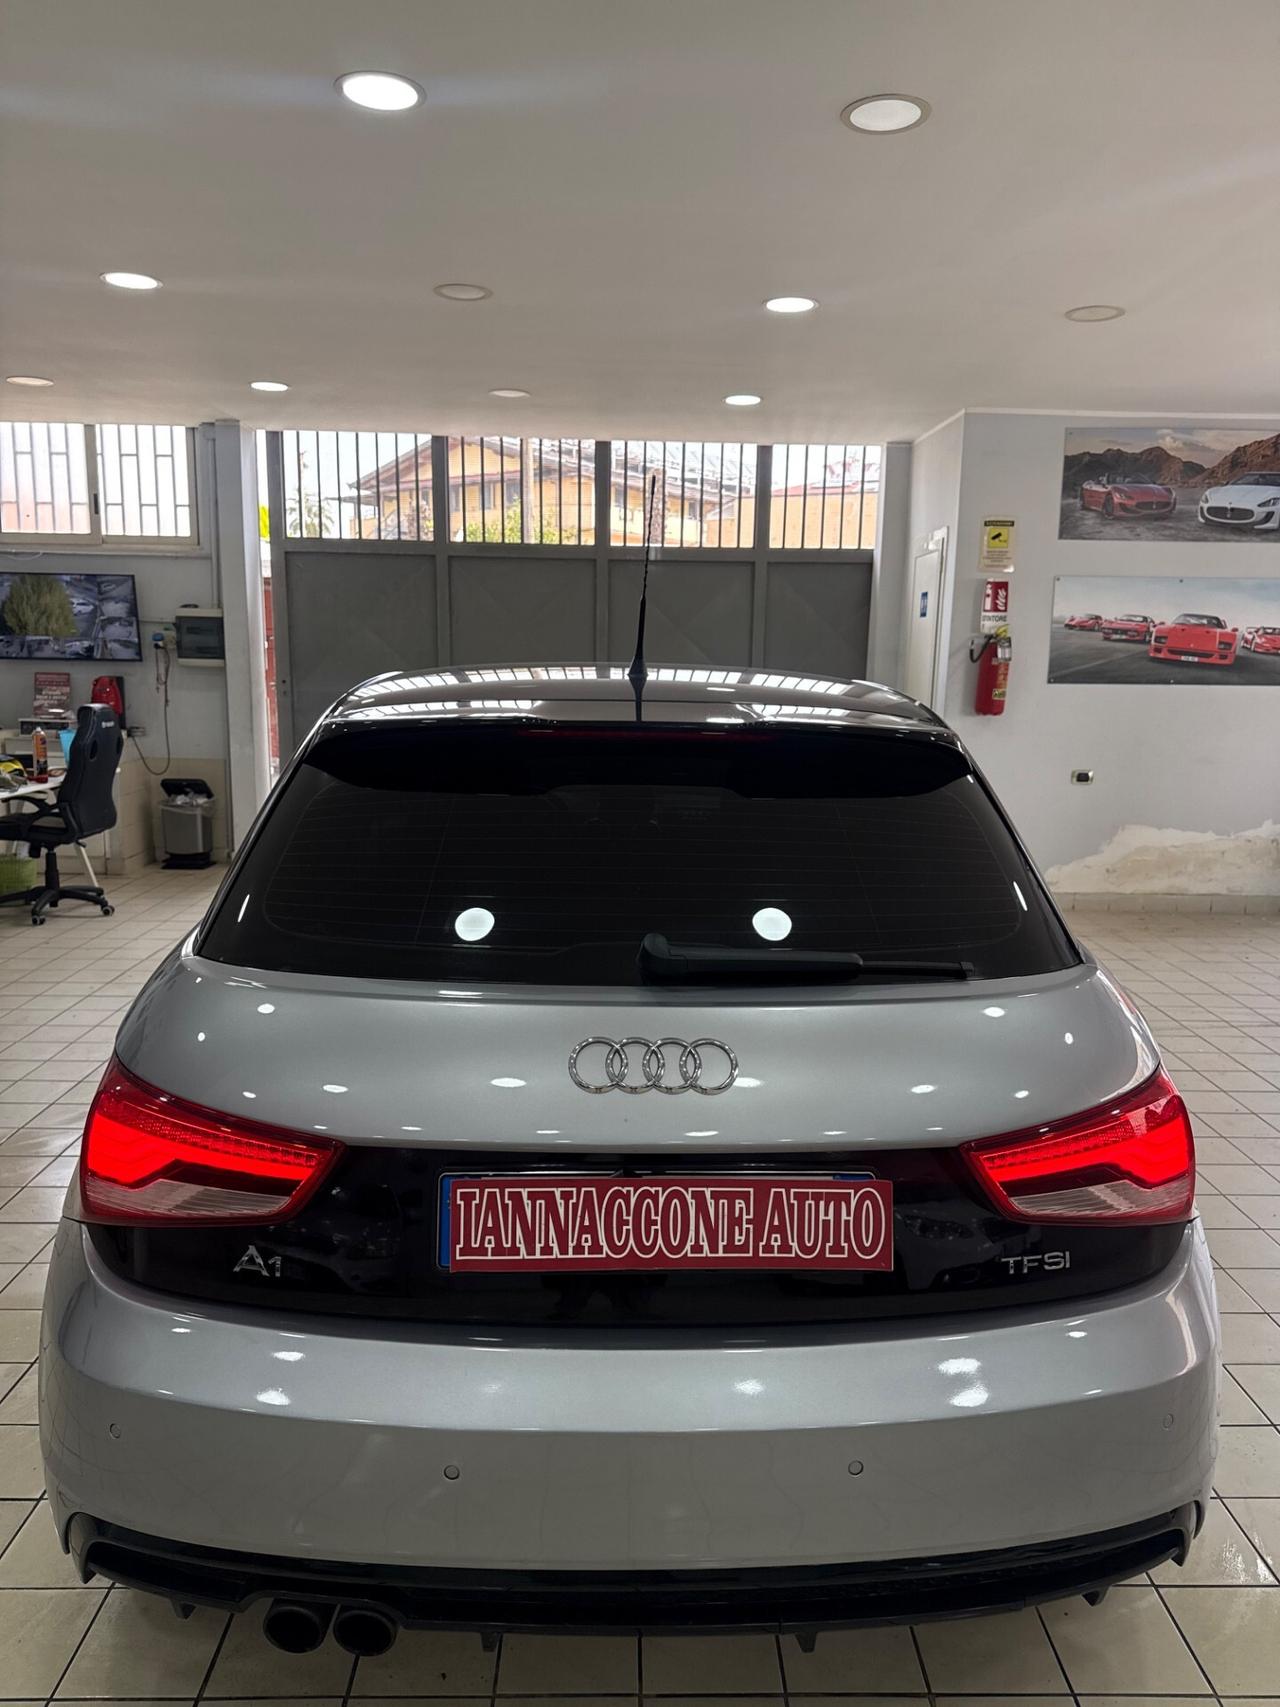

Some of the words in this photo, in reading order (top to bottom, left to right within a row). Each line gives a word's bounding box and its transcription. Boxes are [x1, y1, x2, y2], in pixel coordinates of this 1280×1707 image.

[456, 1186, 754, 1259] IANNACCONE
[759, 1187, 886, 1259] AUTO
[233, 1245, 281, 1277] A1
[1001, 1251, 1070, 1274] TFSI
